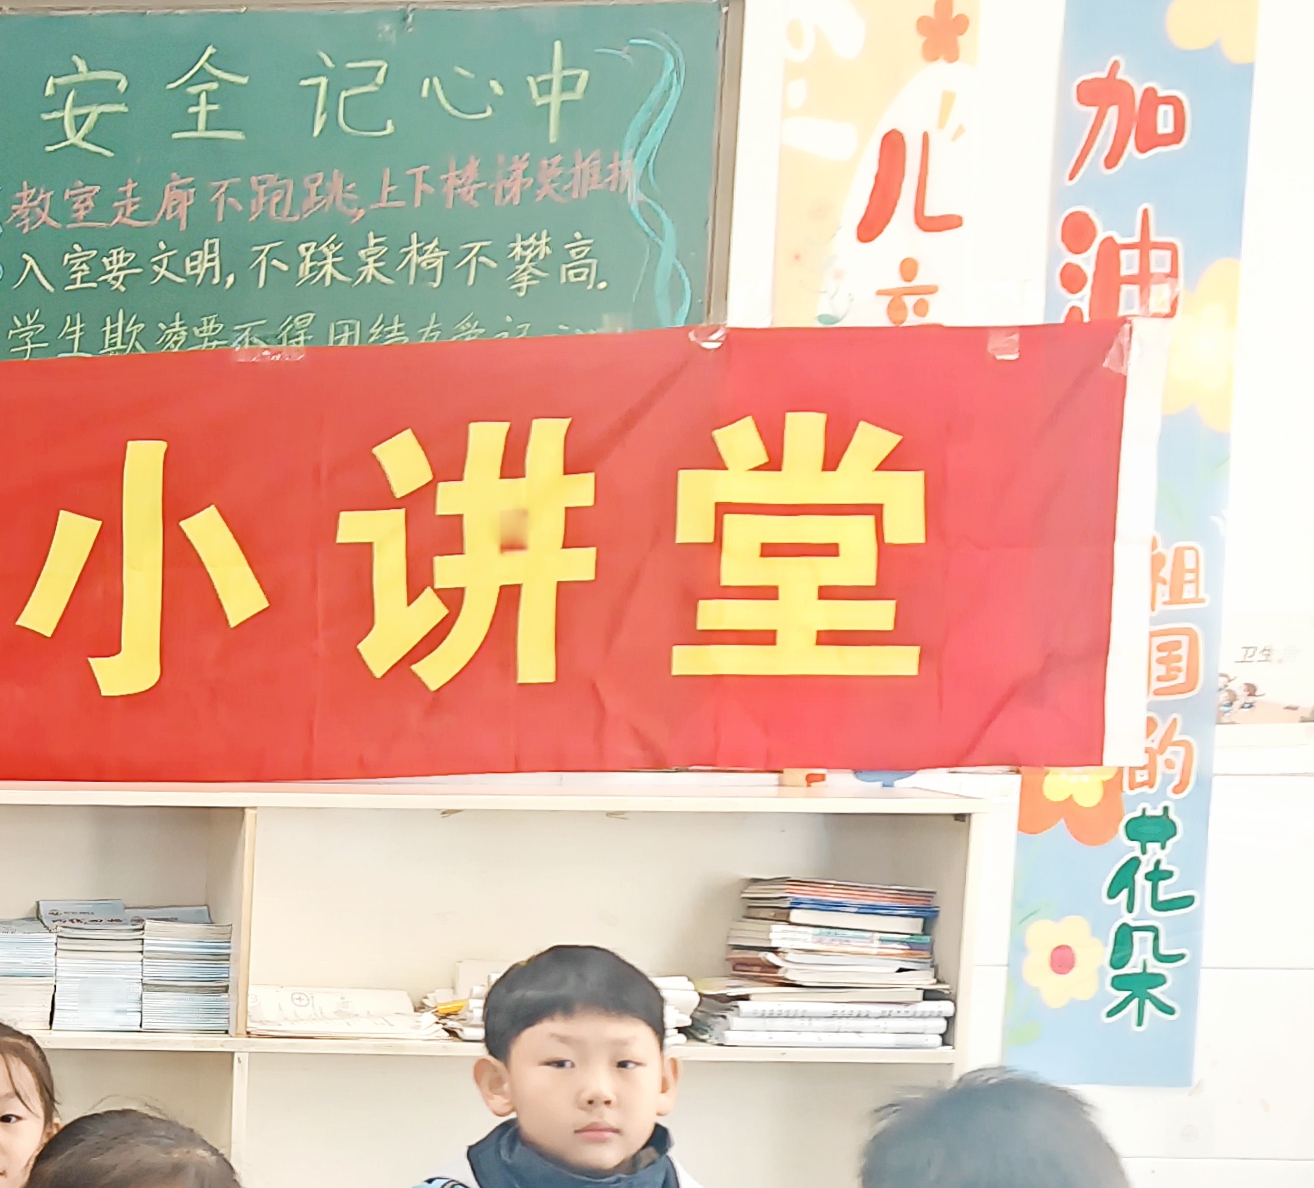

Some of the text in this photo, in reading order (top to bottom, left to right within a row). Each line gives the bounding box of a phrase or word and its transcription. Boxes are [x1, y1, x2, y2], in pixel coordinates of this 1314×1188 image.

[1059, 60, 1186, 322] 加油
[1106, 534, 1207, 1027] 祖国的花朵
